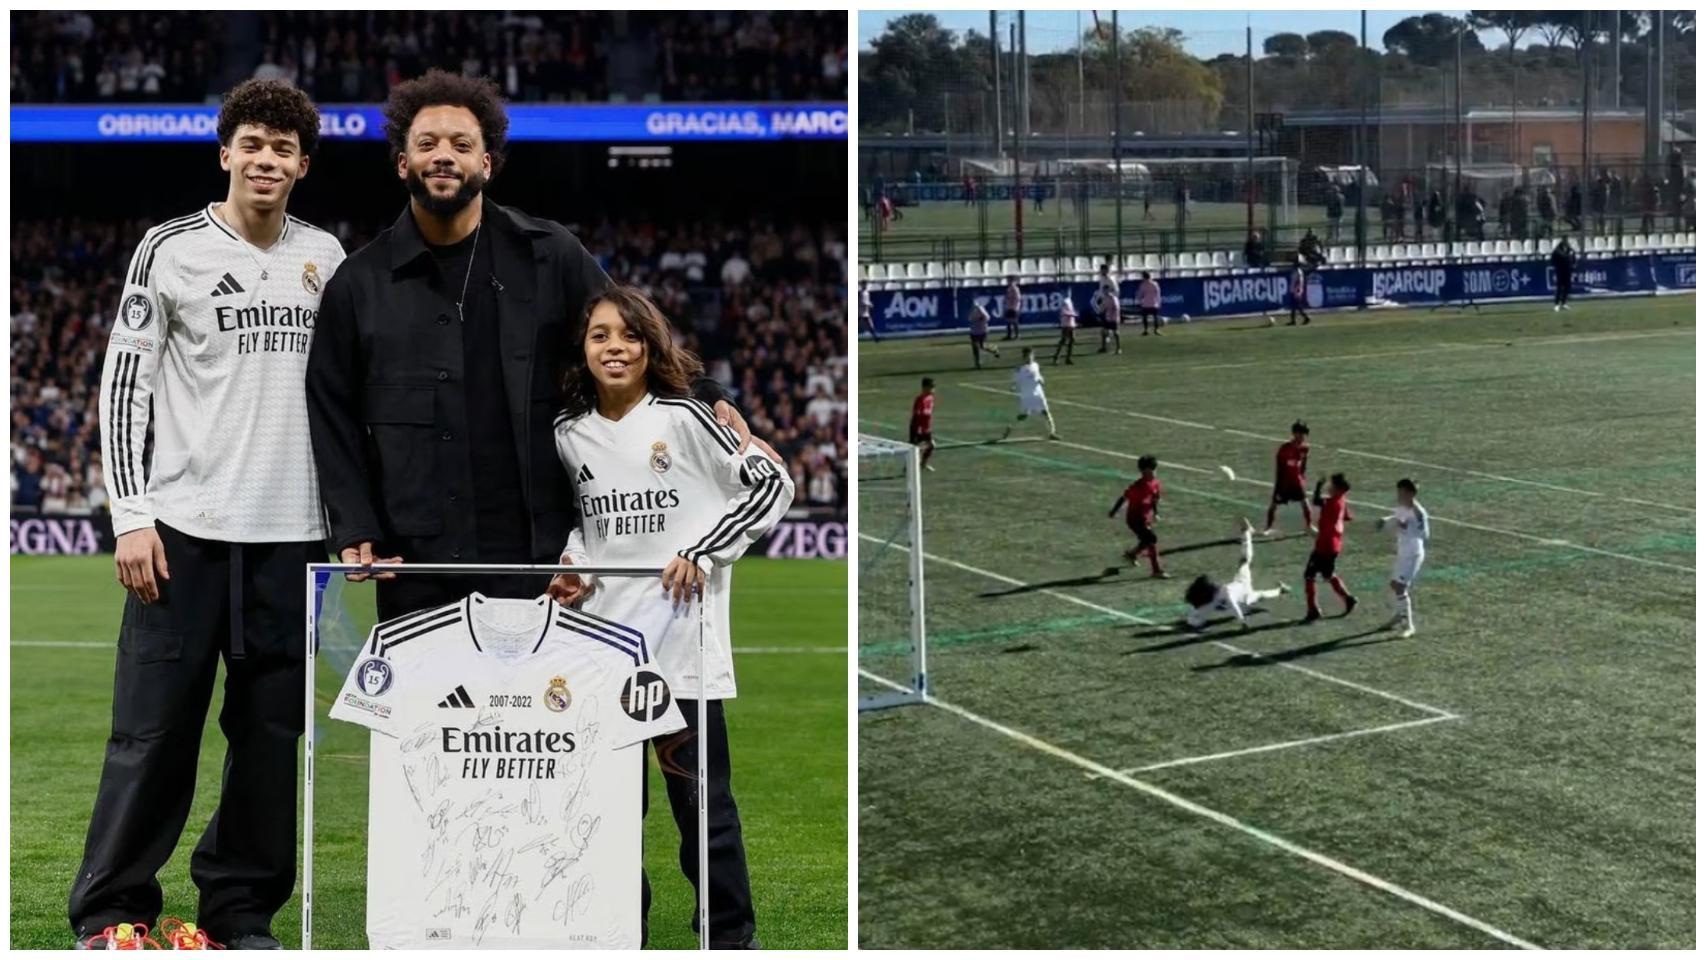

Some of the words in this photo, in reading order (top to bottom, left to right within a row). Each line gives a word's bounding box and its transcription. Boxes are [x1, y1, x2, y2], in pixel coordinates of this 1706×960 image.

[98, 114, 218, 136] OBRIGAD
[646, 111, 766, 137] GRACIAS,
[771, 110, 848, 135] MARC
[1203, 275, 1288, 311] ISCARCUP
[1372, 268, 1447, 299] ISCARCUP
[131, 310, 142, 319] 15
[215, 300, 320, 332] Emirates
[884, 292, 939, 318] AON
[992, 290, 1063, 318] Jma
[238, 332, 259, 355] FLY
[264, 331, 308, 354] BETTER
[580, 488, 680, 518] Emirates
[615, 513, 666, 536] BETTER
[767, 521, 848, 558] ZEG
[368, 675, 380, 686] 15
[489, 694, 532, 708] 2007-2022
[628, 671, 664, 722] hp
[441, 725, 576, 753] Emirates
[462, 757, 490, 779] FLY
[495, 758, 556, 779] BETTER
